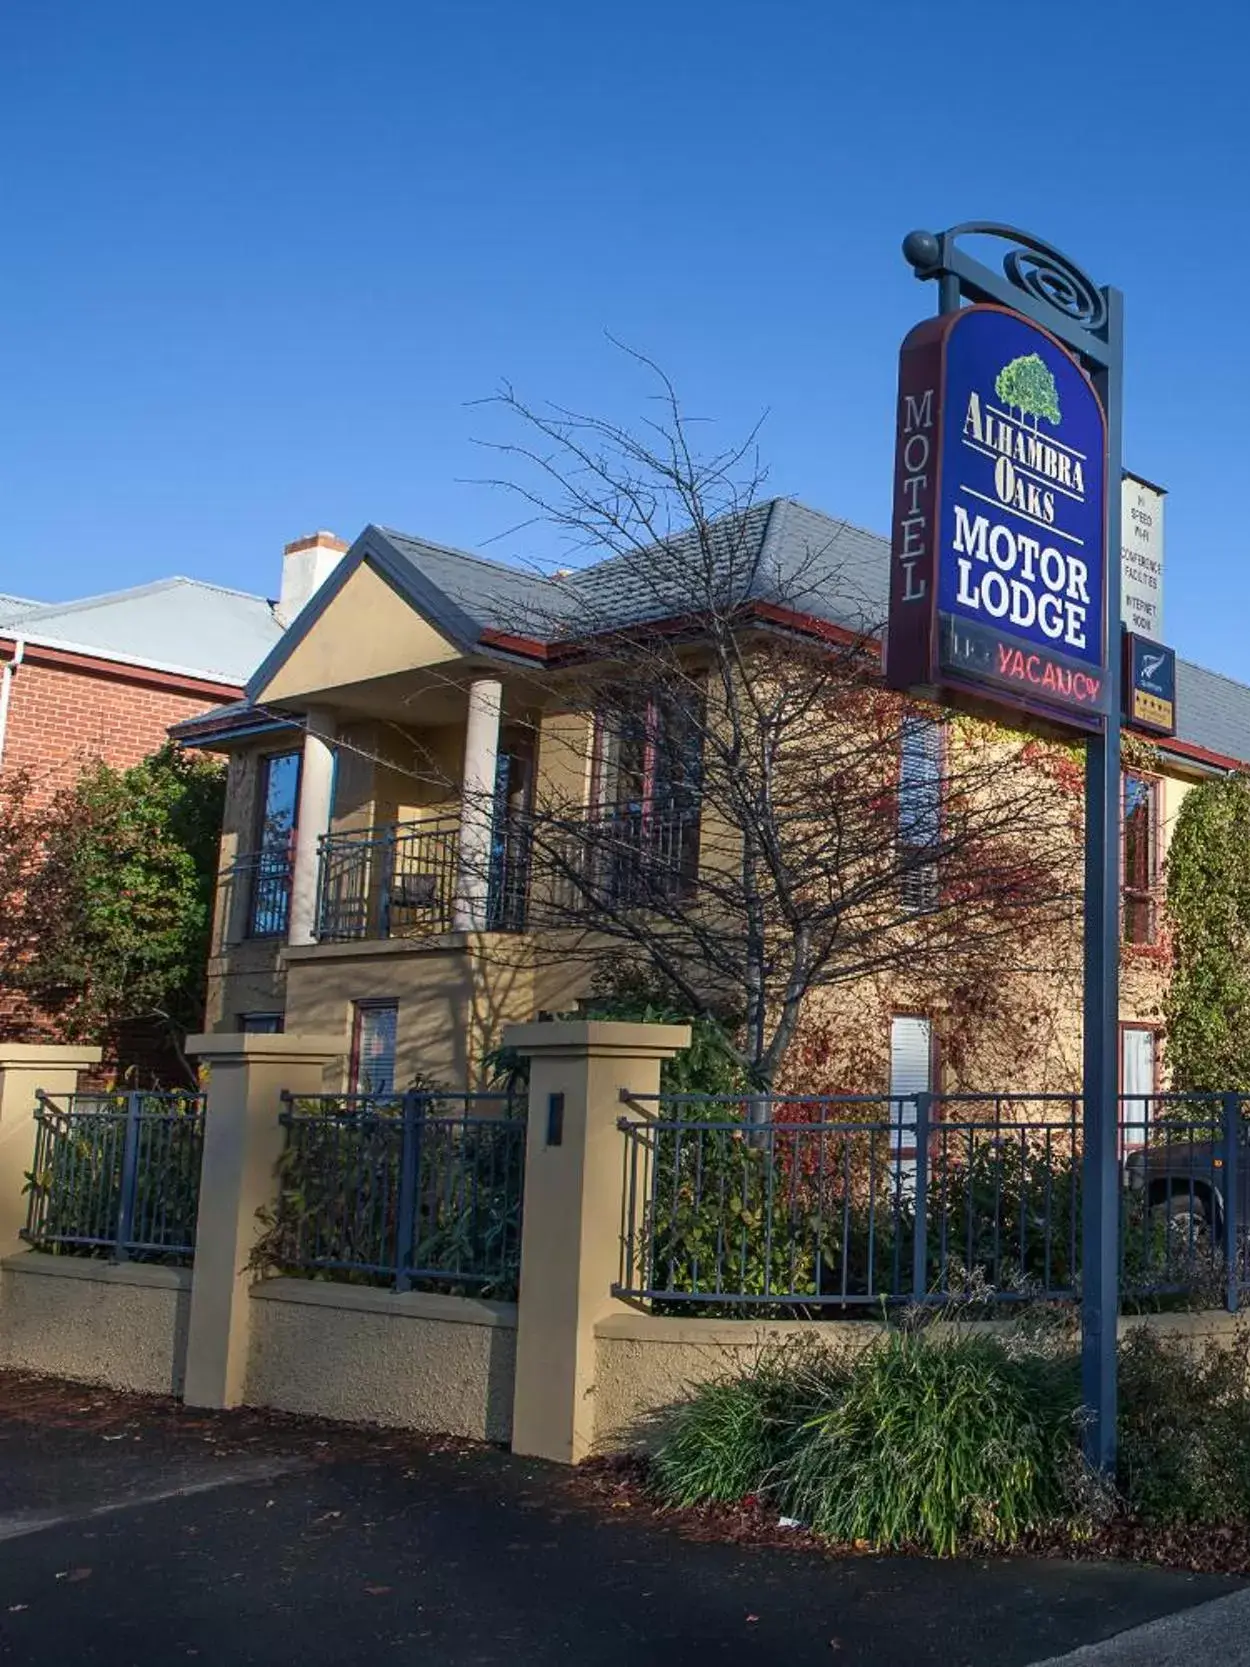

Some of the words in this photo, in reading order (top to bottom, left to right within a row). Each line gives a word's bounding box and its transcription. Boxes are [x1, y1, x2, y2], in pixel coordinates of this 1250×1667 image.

[899, 389, 934, 602] MOTEL
[1131, 507, 1153, 527] SPEED
[953, 504, 1090, 605] MOTOR
[956, 557, 1087, 650] LODGE
[1126, 595, 1157, 617] INTERNET
[998, 643, 1100, 702] VACANCY
